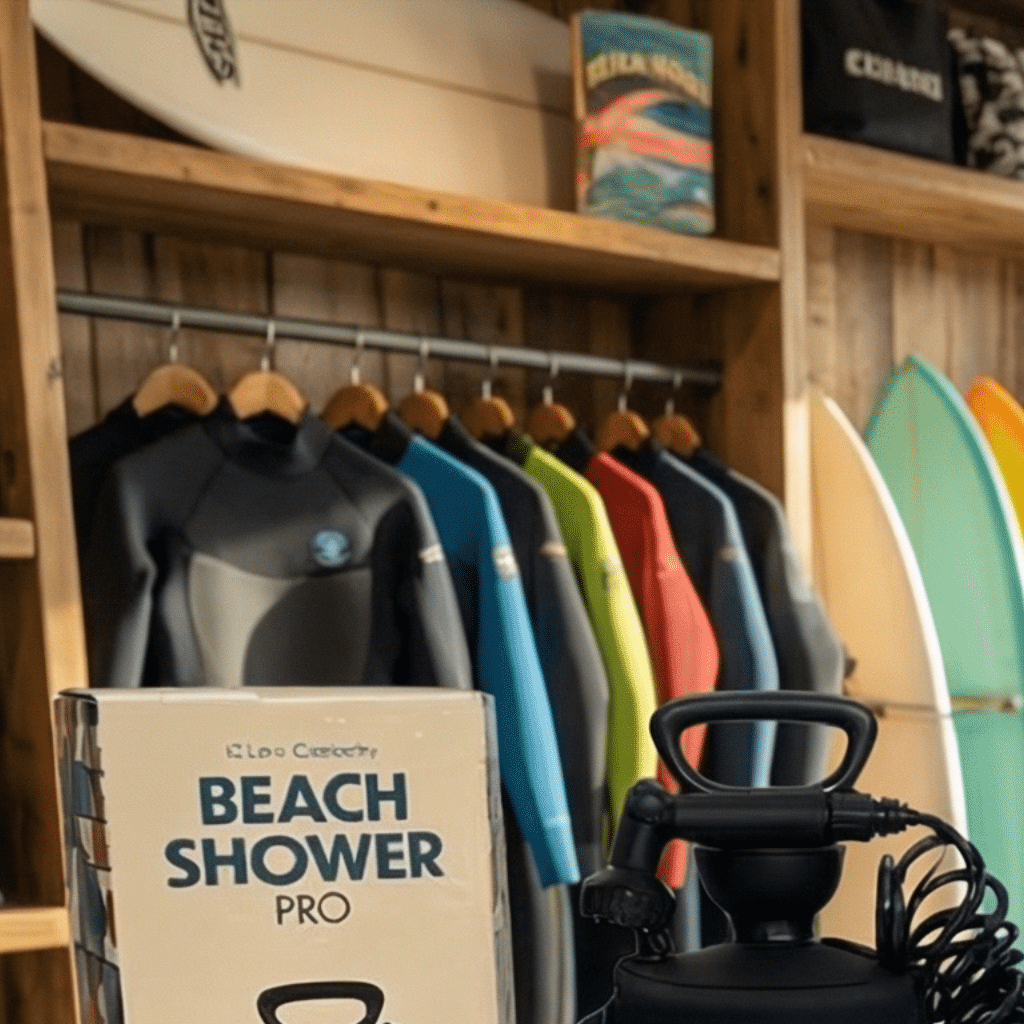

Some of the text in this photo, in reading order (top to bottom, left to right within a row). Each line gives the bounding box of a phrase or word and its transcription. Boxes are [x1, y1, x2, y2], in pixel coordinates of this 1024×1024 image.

[198, 772, 408, 826] BEACH
[164, 831, 445, 889] SHOWER
[275, 891, 351, 926] PRO
